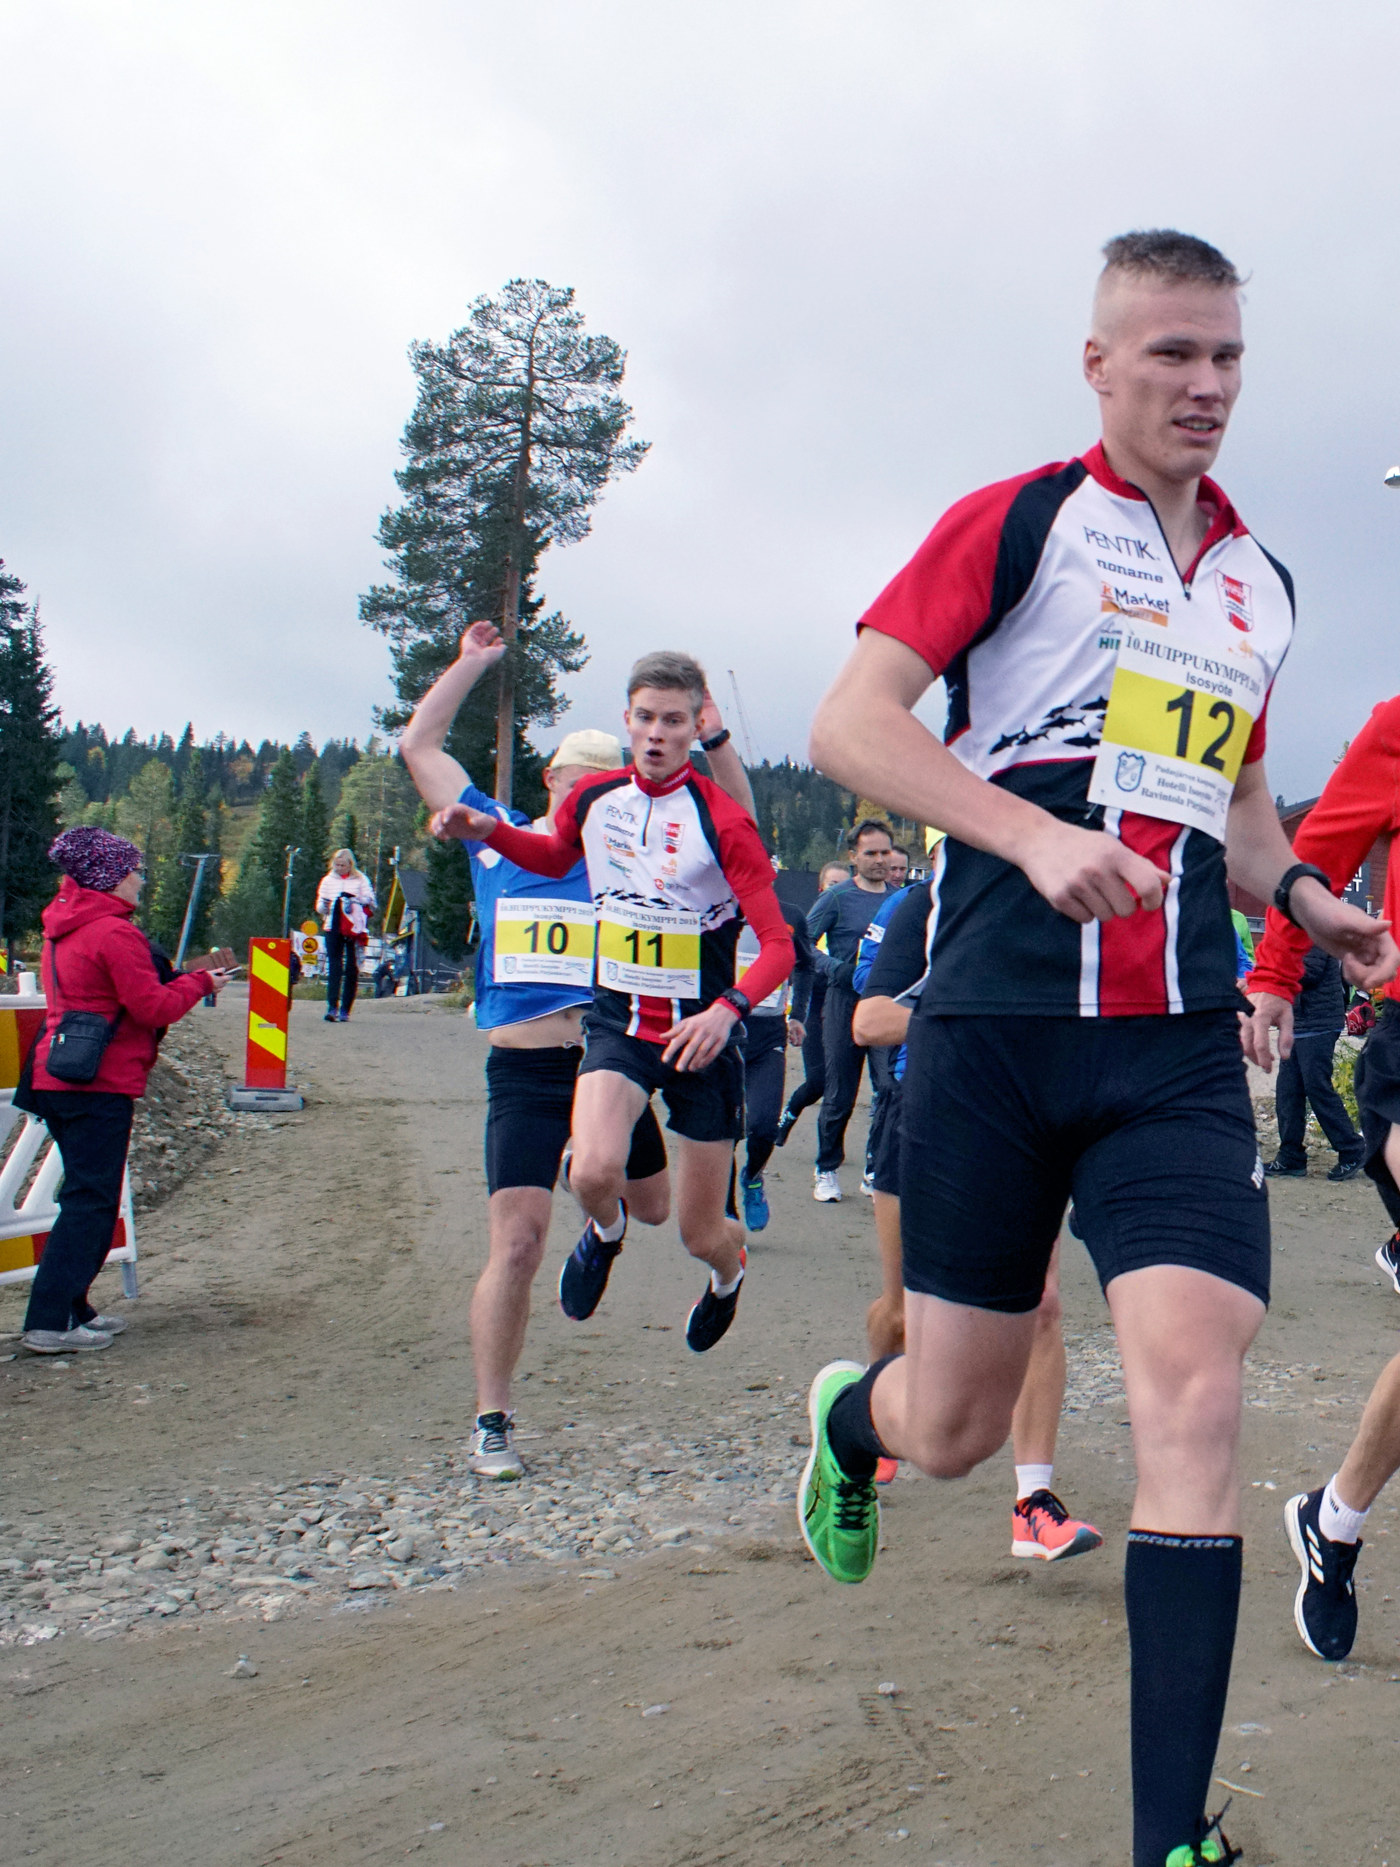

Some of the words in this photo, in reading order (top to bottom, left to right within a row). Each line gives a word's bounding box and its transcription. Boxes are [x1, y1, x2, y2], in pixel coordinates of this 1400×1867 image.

[1083, 525, 1156, 560] PENTIK
[1096, 559, 1163, 584] noname
[1114, 586, 1170, 613] Market
[1186, 671, 1233, 697] Isosyöte
[1166, 688, 1235, 772] 12
[524, 921, 569, 955] 10
[624, 929, 663, 968] 11
